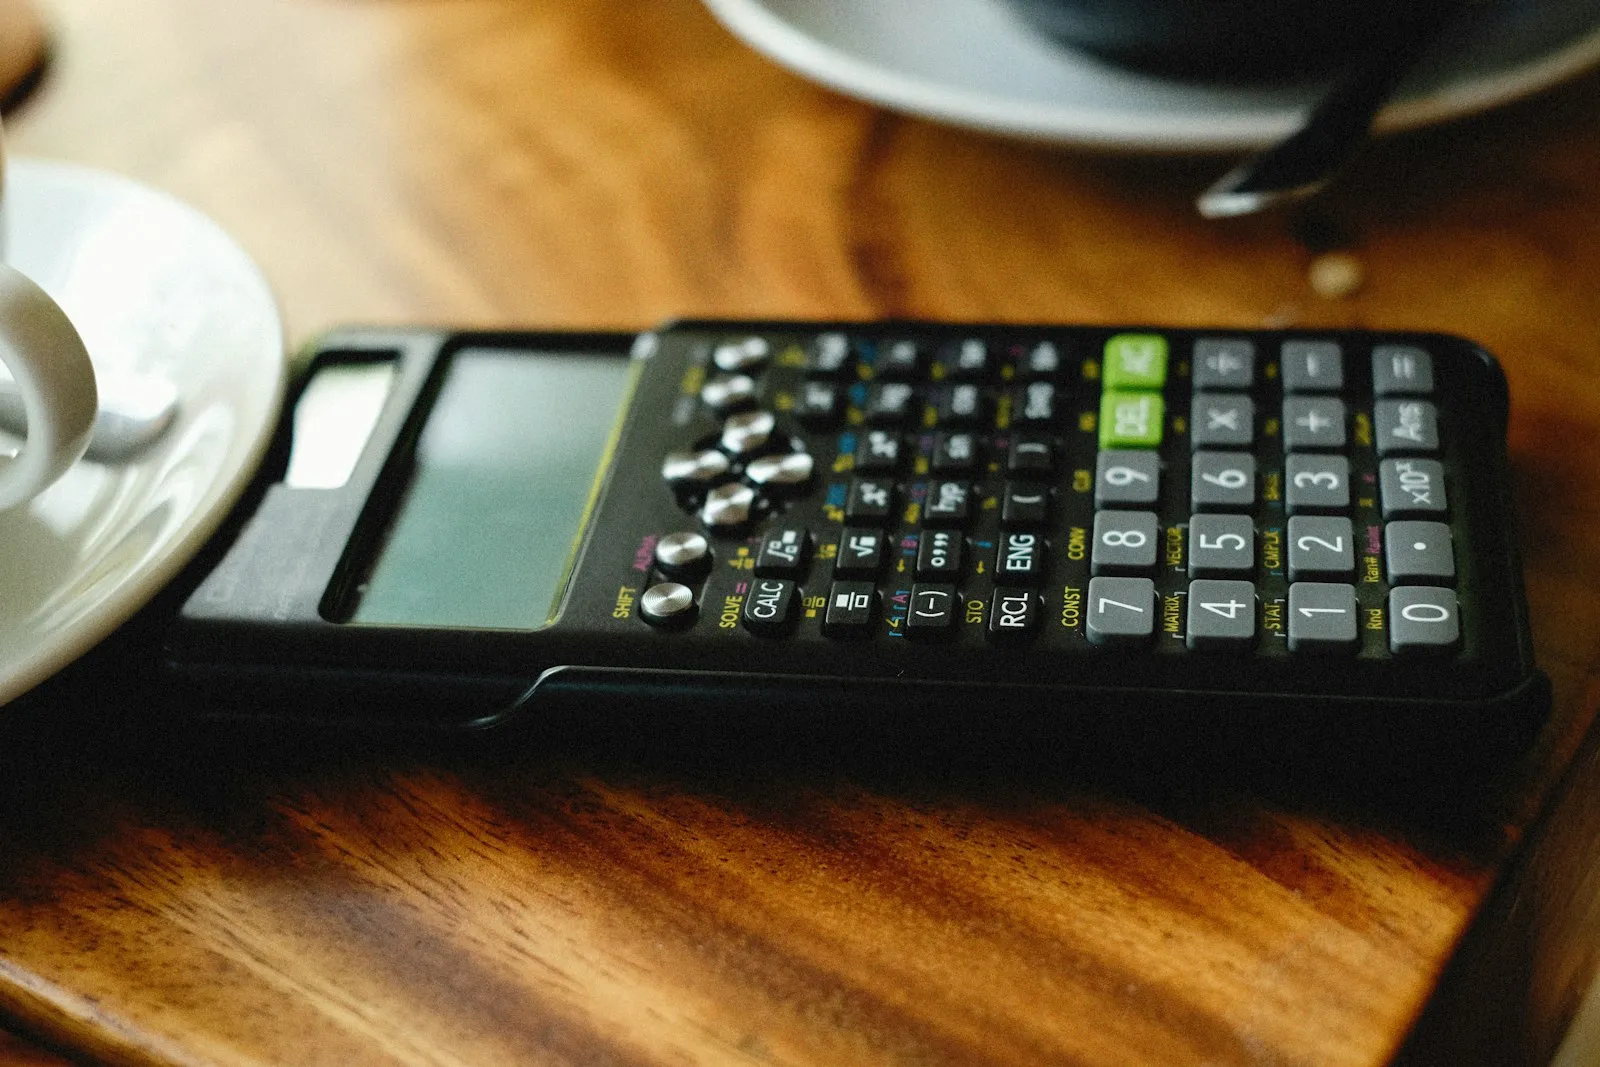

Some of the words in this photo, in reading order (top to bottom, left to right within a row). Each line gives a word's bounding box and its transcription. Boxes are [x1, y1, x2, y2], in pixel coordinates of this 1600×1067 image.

[1114, 394, 1149, 437] DEL
[1391, 402, 1423, 442] Ans
[1104, 465, 1149, 486] 9
[1201, 468, 1248, 489] 6
[1293, 470, 1339, 491] 3
[930, 482, 968, 512] hyp
[1006, 533, 1036, 571] ENG
[1067, 526, 1086, 560] CONV
[1101, 529, 1147, 548] 8
[1166, 526, 1183, 567] VECTOR
[1200, 533, 1246, 551] 5
[1263, 529, 1280, 569] CMPLX
[1297, 535, 1344, 553] 2
[1364, 556, 1380, 583] Ran#
[612, 584, 636, 620] SHIFT
[719, 594, 742, 629] SOLVE
[753, 581, 784, 618] CALC
[965, 599, 984, 624] STO
[1000, 592, 1029, 628] RCL
[1061, 585, 1081, 627] CONST
[1098, 597, 1144, 614] 7
[1163, 595, 1180, 633] MATRIX
[1200, 599, 1246, 619] 4
[1298, 608, 1346, 618] 1
[1401, 603, 1450, 622] 0
[1264, 602, 1281, 631] STAT
[1366, 608, 1383, 630] Rnd
